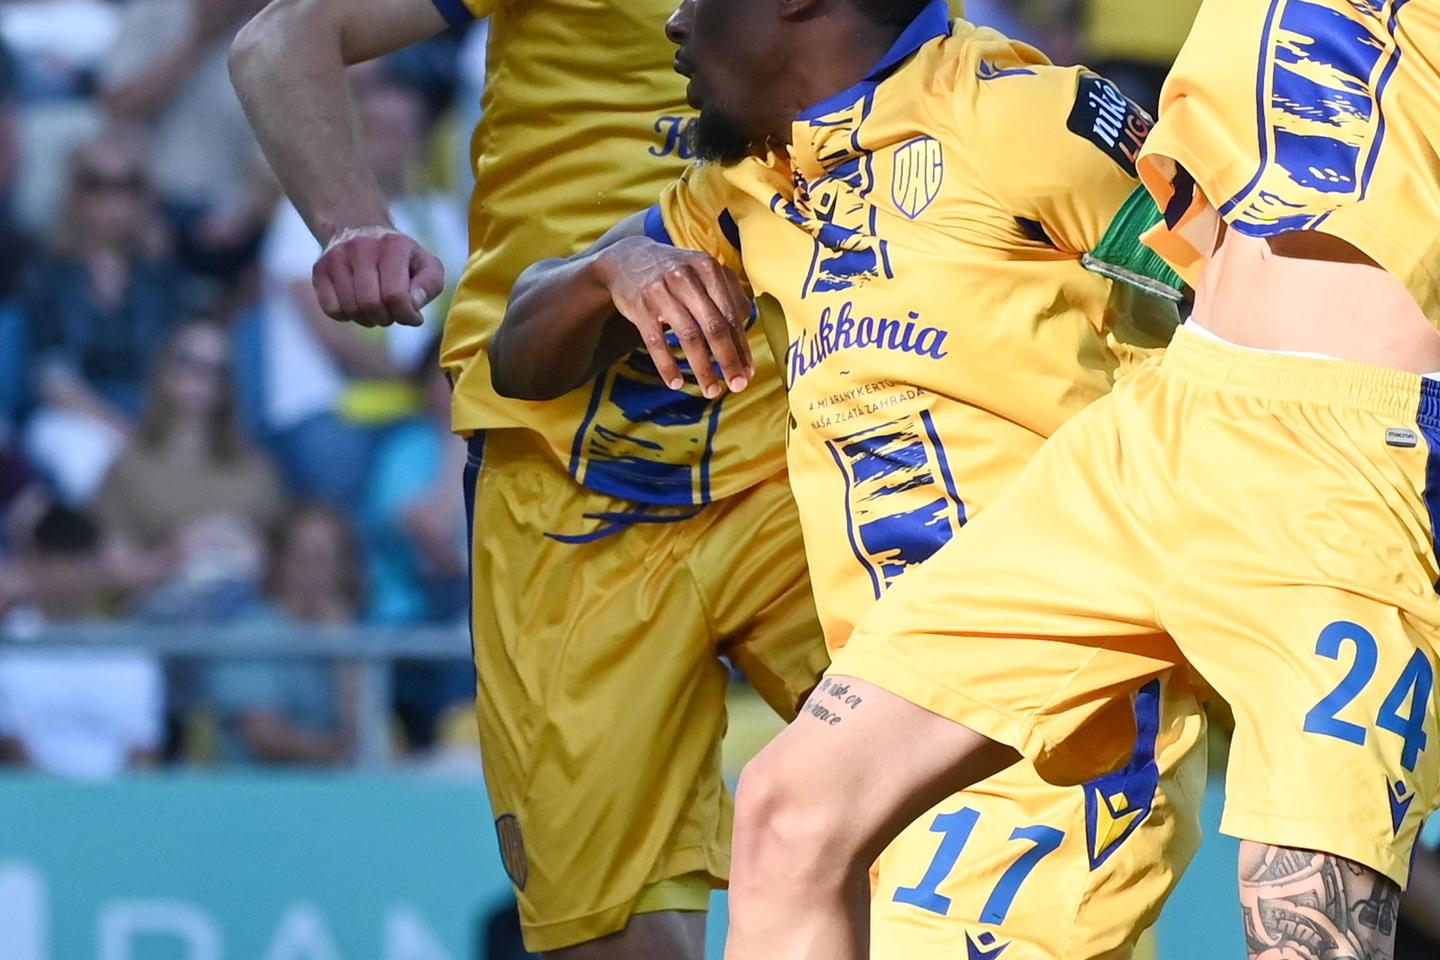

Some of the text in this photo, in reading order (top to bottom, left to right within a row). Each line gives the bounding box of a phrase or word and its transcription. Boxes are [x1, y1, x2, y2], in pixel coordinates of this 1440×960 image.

[1088, 80, 1127, 148] niké
[784, 300, 949, 393] Kukkonia
[1303, 620, 1435, 773] 24
[891, 806, 1065, 927] 17
